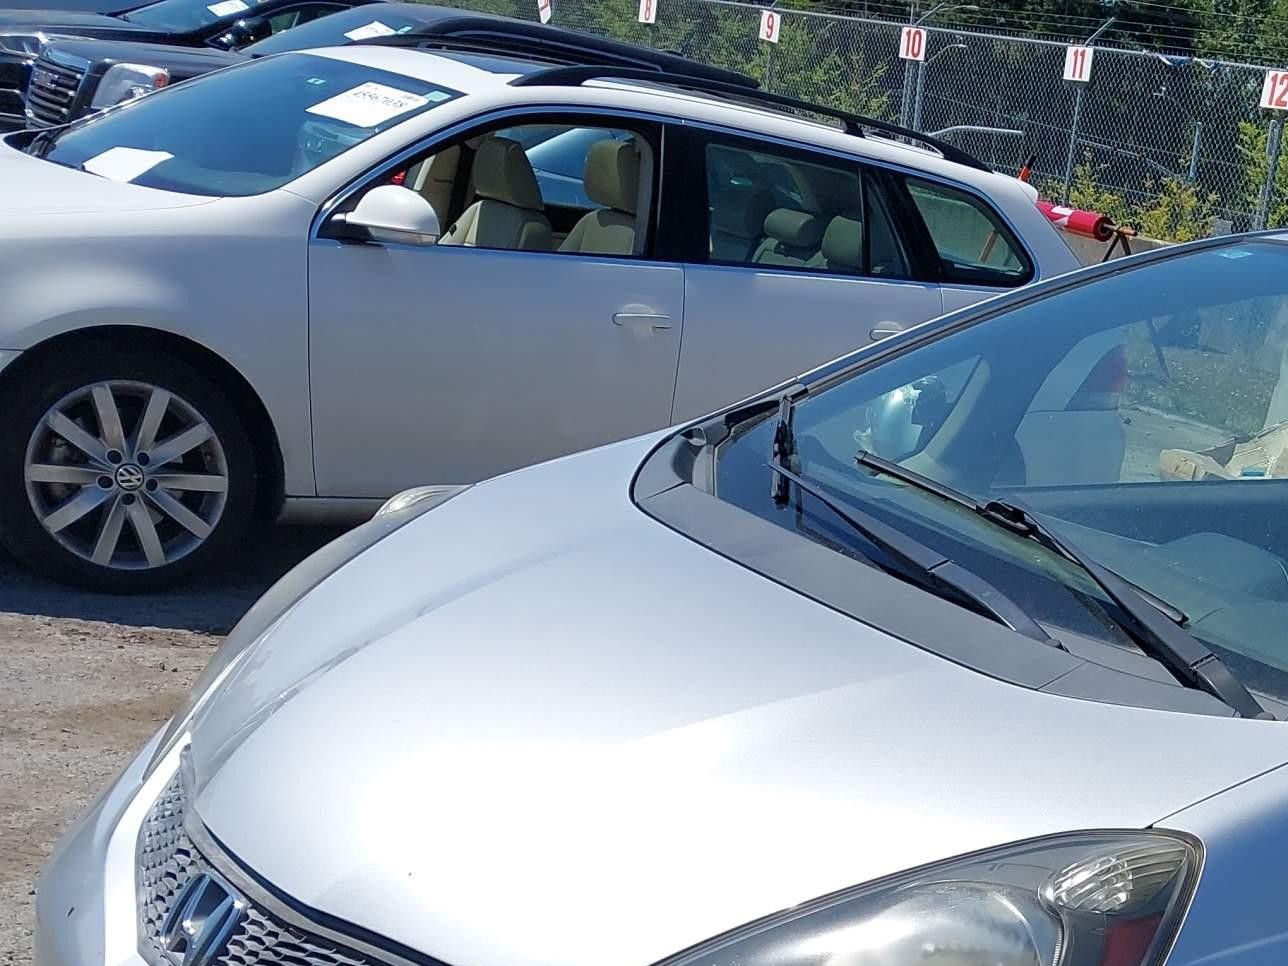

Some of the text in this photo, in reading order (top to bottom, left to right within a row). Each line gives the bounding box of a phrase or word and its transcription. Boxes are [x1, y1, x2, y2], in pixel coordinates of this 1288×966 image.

[765, 13, 775, 39] 9
[904, 29, 923, 59] 10
[1071, 48, 1086, 79] 11
